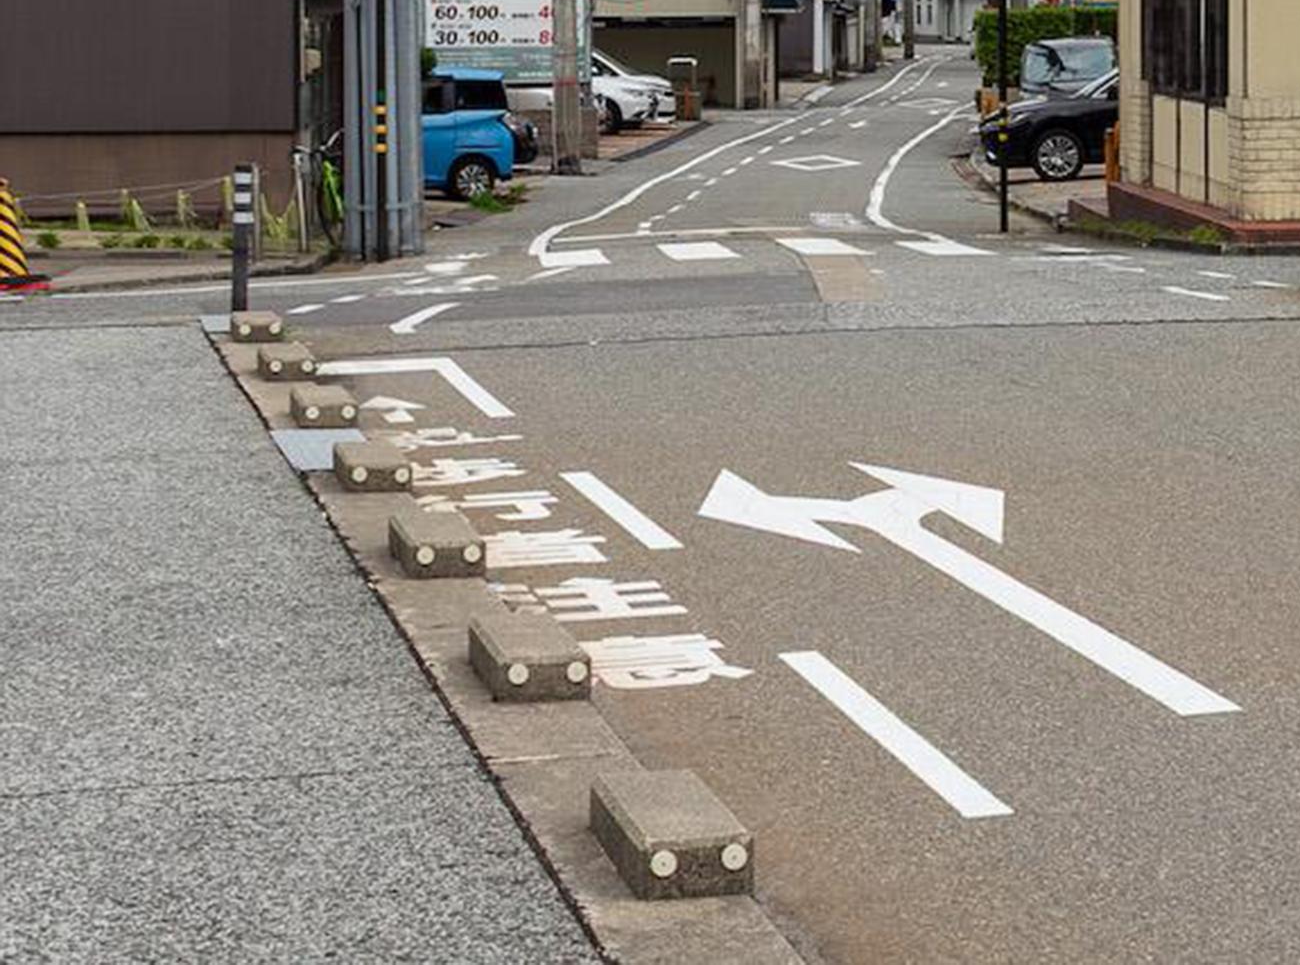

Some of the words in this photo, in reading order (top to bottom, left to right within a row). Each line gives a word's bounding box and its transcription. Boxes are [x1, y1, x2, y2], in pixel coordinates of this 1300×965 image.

[434, 5, 458, 20] 60
[466, 5, 499, 20] 100
[434, 30, 458, 45] 30
[466, 30, 499, 45] 100
